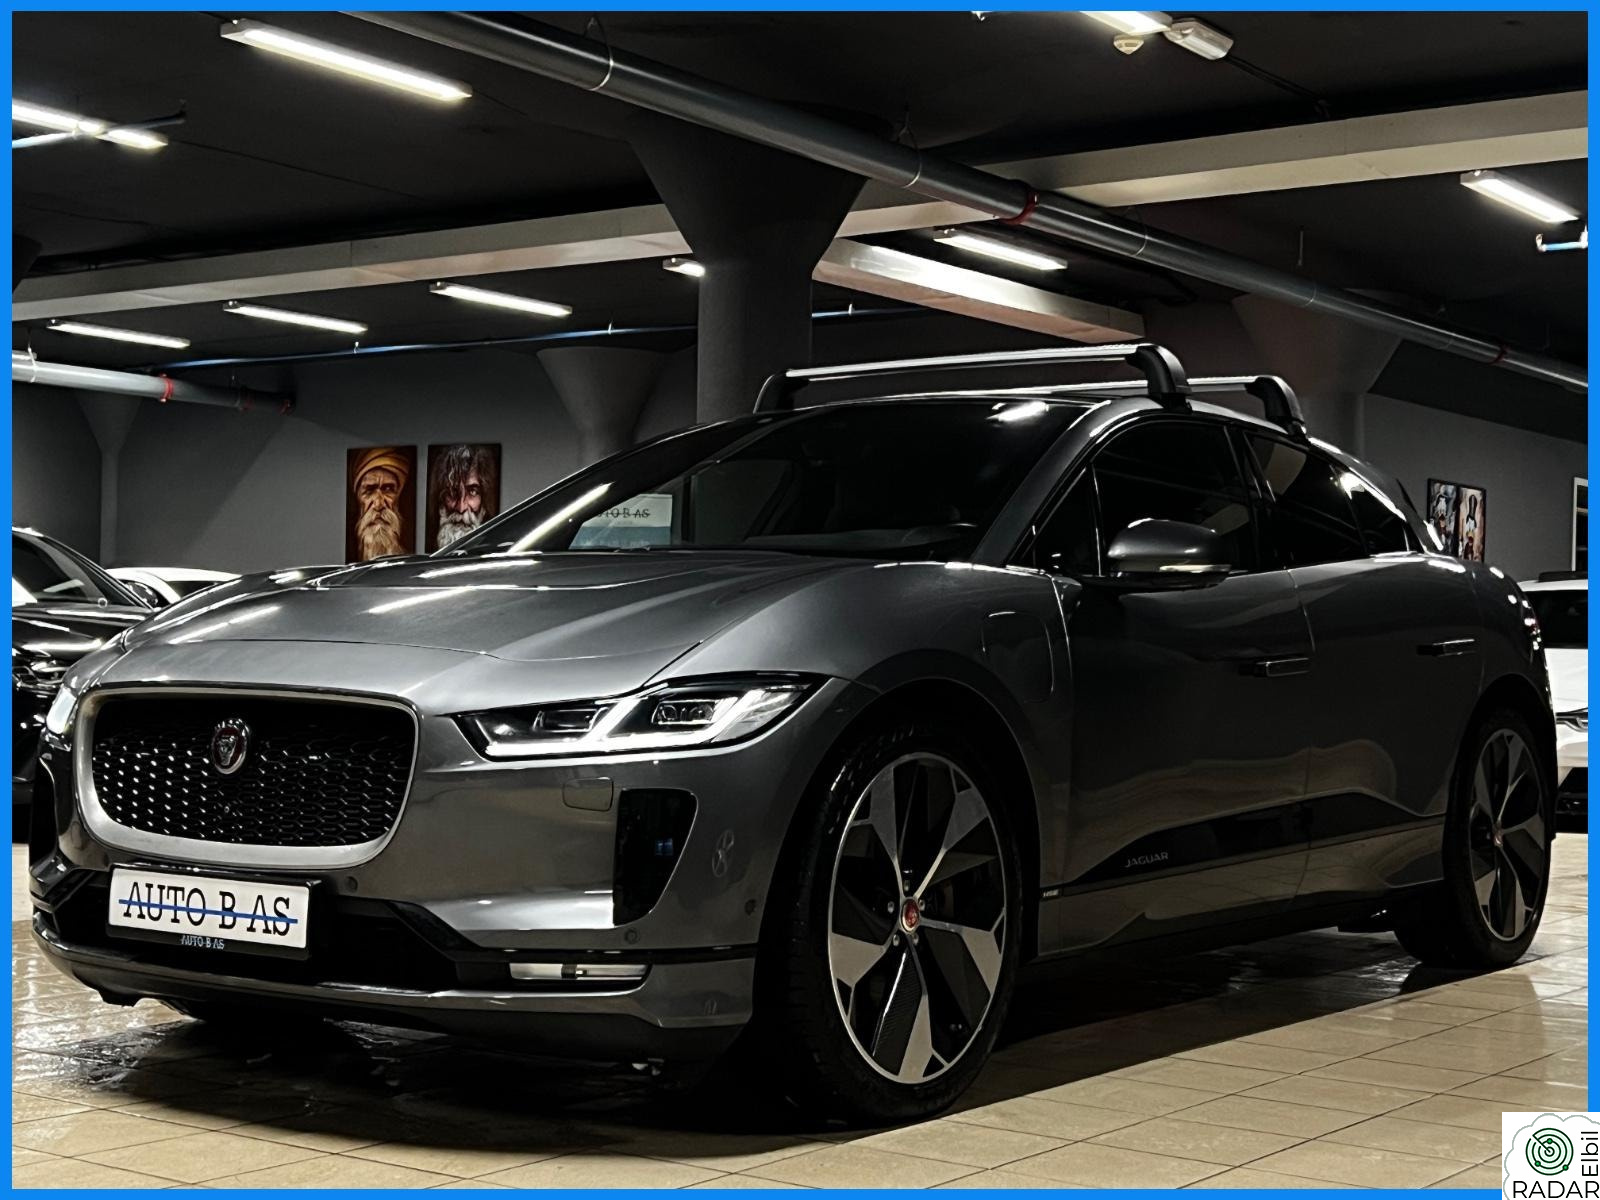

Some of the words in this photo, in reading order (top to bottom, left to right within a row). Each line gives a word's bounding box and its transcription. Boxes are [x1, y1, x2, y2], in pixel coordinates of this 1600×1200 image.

[635, 509, 649, 518] AS
[1125, 852, 1169, 868] JAGUAR
[123, 881, 206, 927] AUTO
[218, 890, 237, 930] B
[246, 894, 291, 937] AS
[181, 934, 204, 947] AUTO
[206, 937, 212, 948] B
[213, 938, 225, 950] AS
